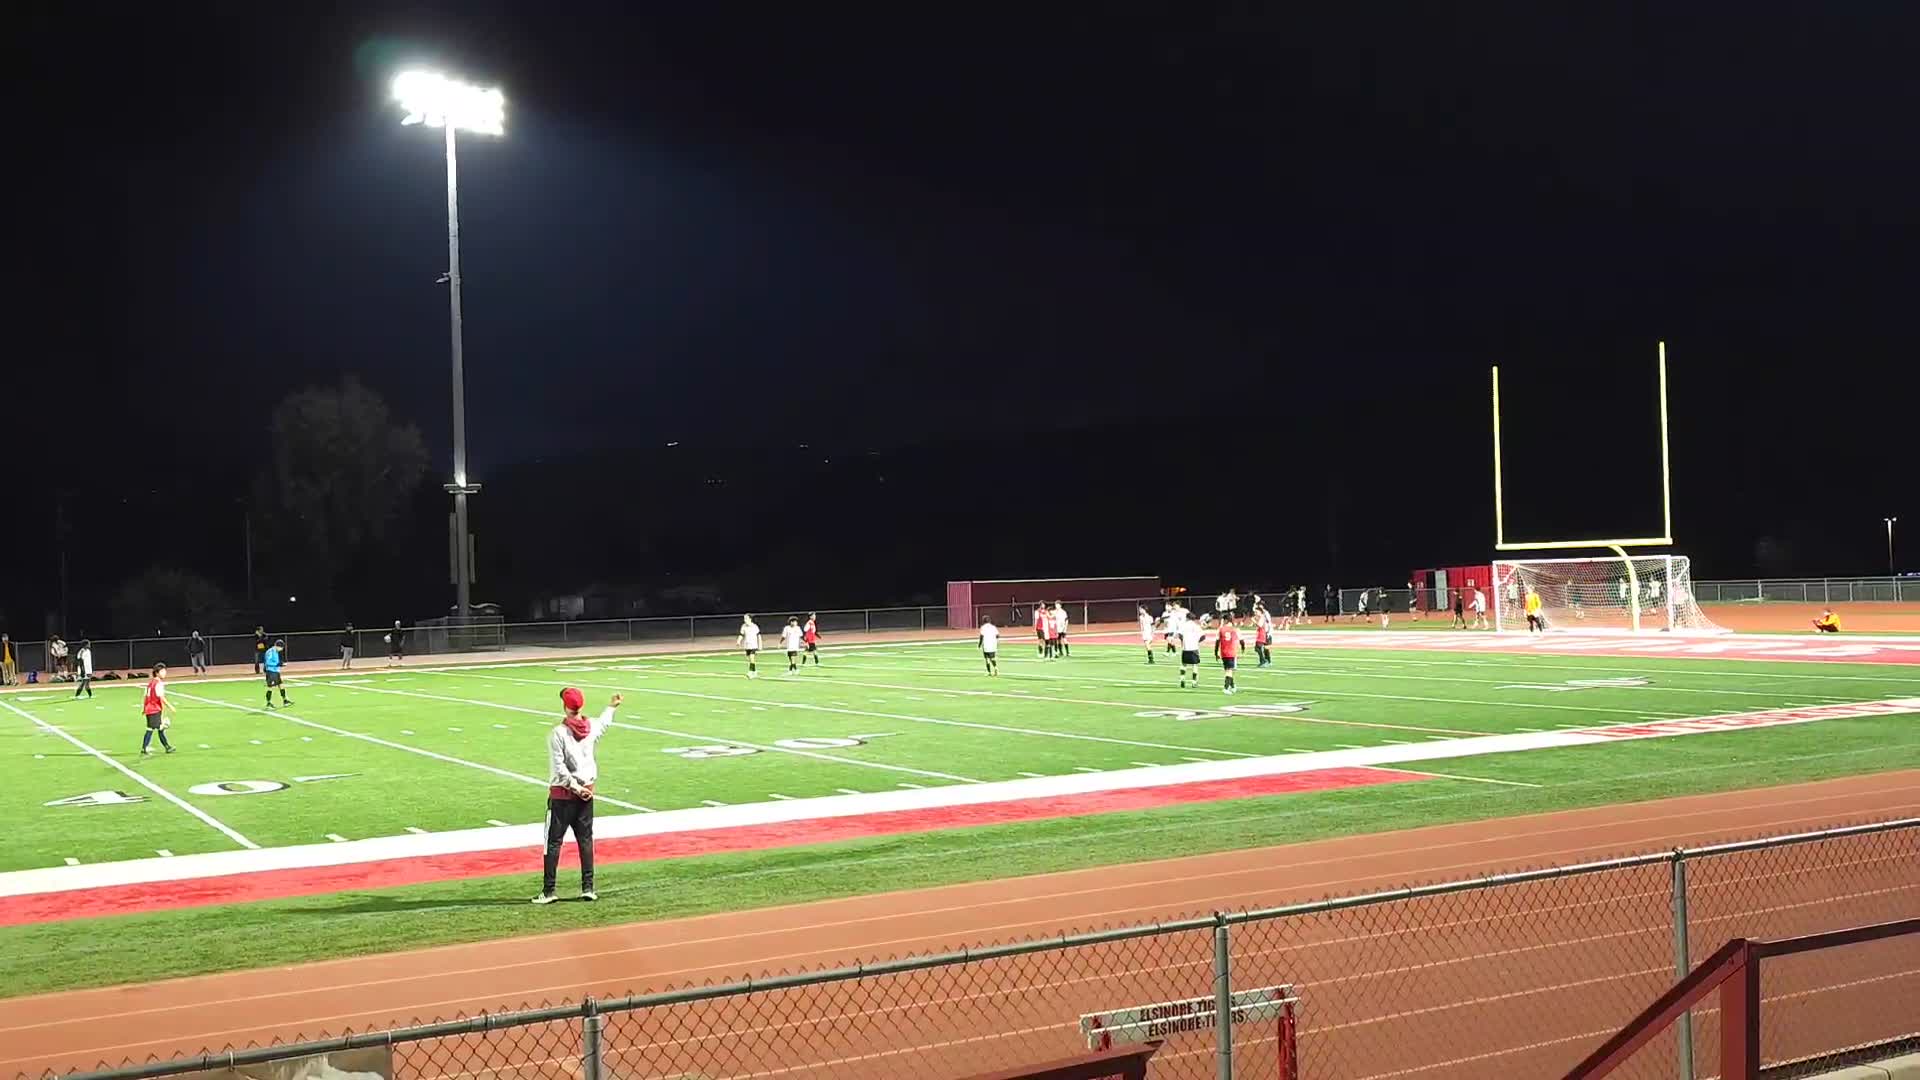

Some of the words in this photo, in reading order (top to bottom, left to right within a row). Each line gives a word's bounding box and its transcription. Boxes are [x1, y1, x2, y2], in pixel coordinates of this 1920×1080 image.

[1139, 1002, 1193, 1022] ELSINORE
[1148, 1016, 1202, 1037] ELSINORE
[1205, 1010, 1245, 1027] TIRS
